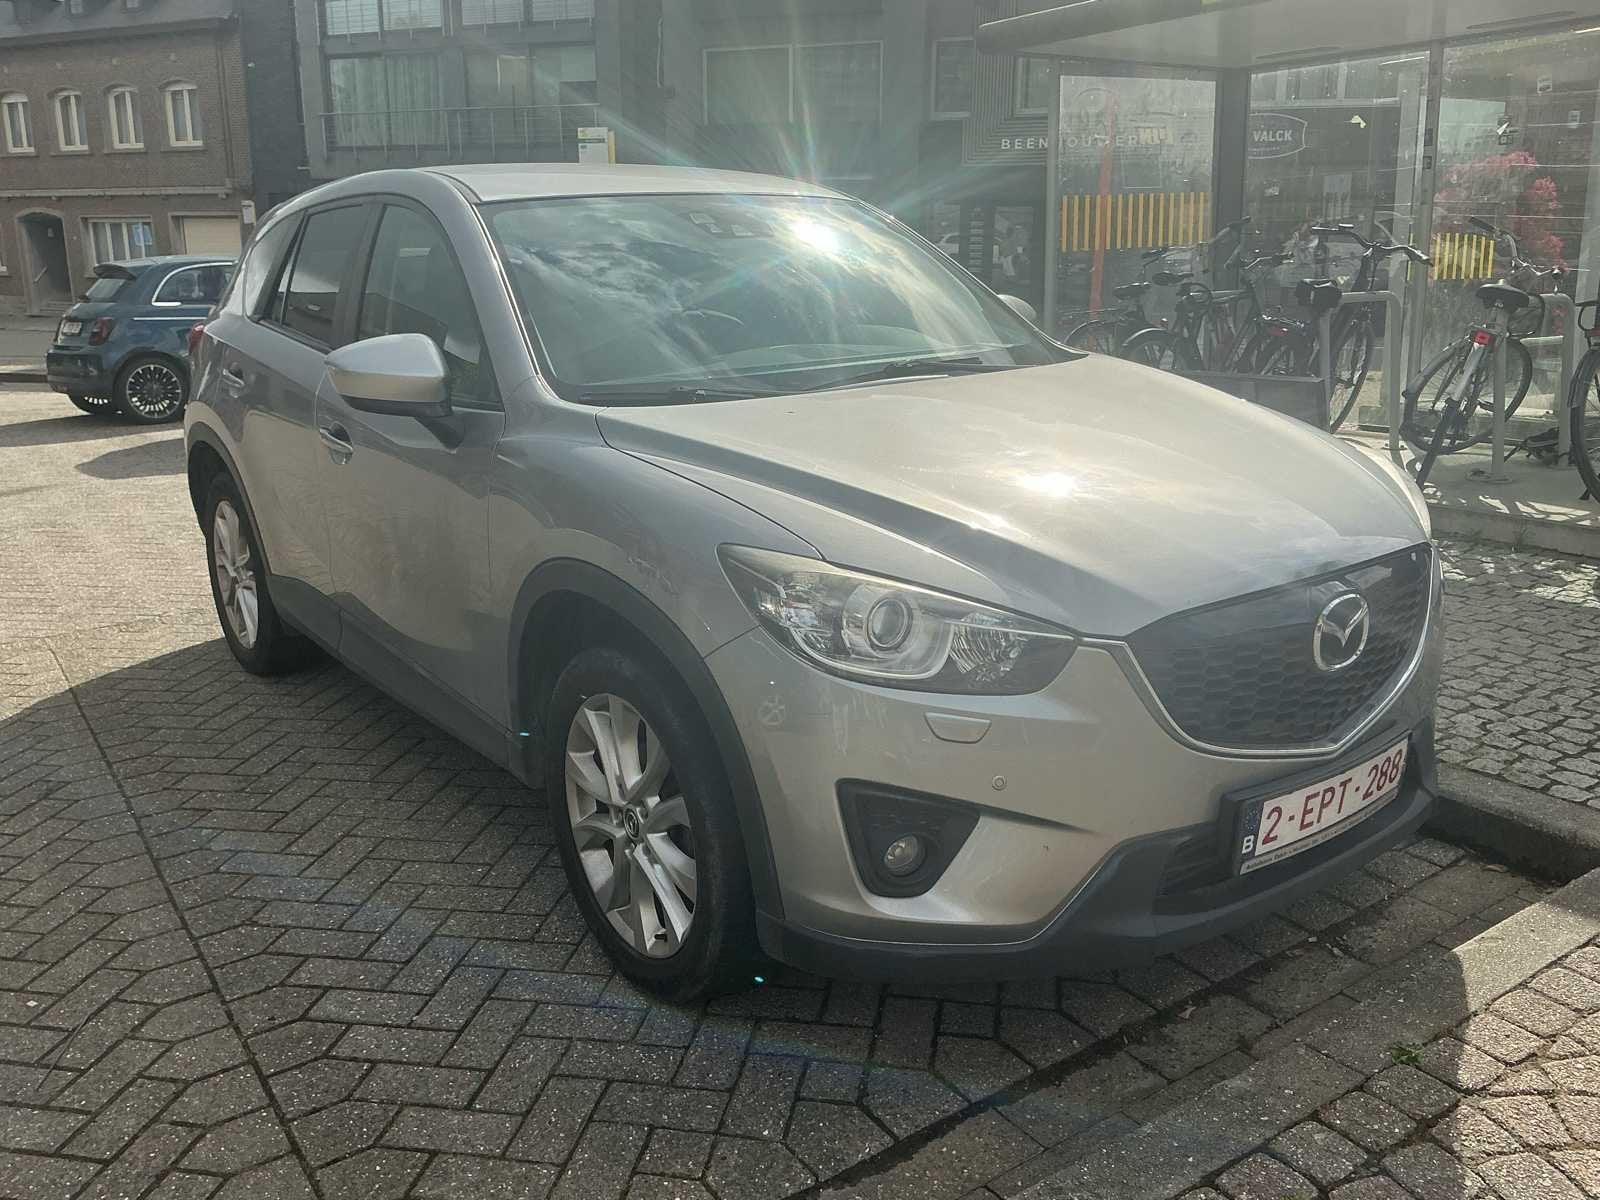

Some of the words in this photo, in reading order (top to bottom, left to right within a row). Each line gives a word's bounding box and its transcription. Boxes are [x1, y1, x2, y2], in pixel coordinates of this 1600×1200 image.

[1252, 129, 1293, 142] VALCK
[1261, 748, 1403, 846] 2-EPT-288
[1241, 835, 1255, 855] B
